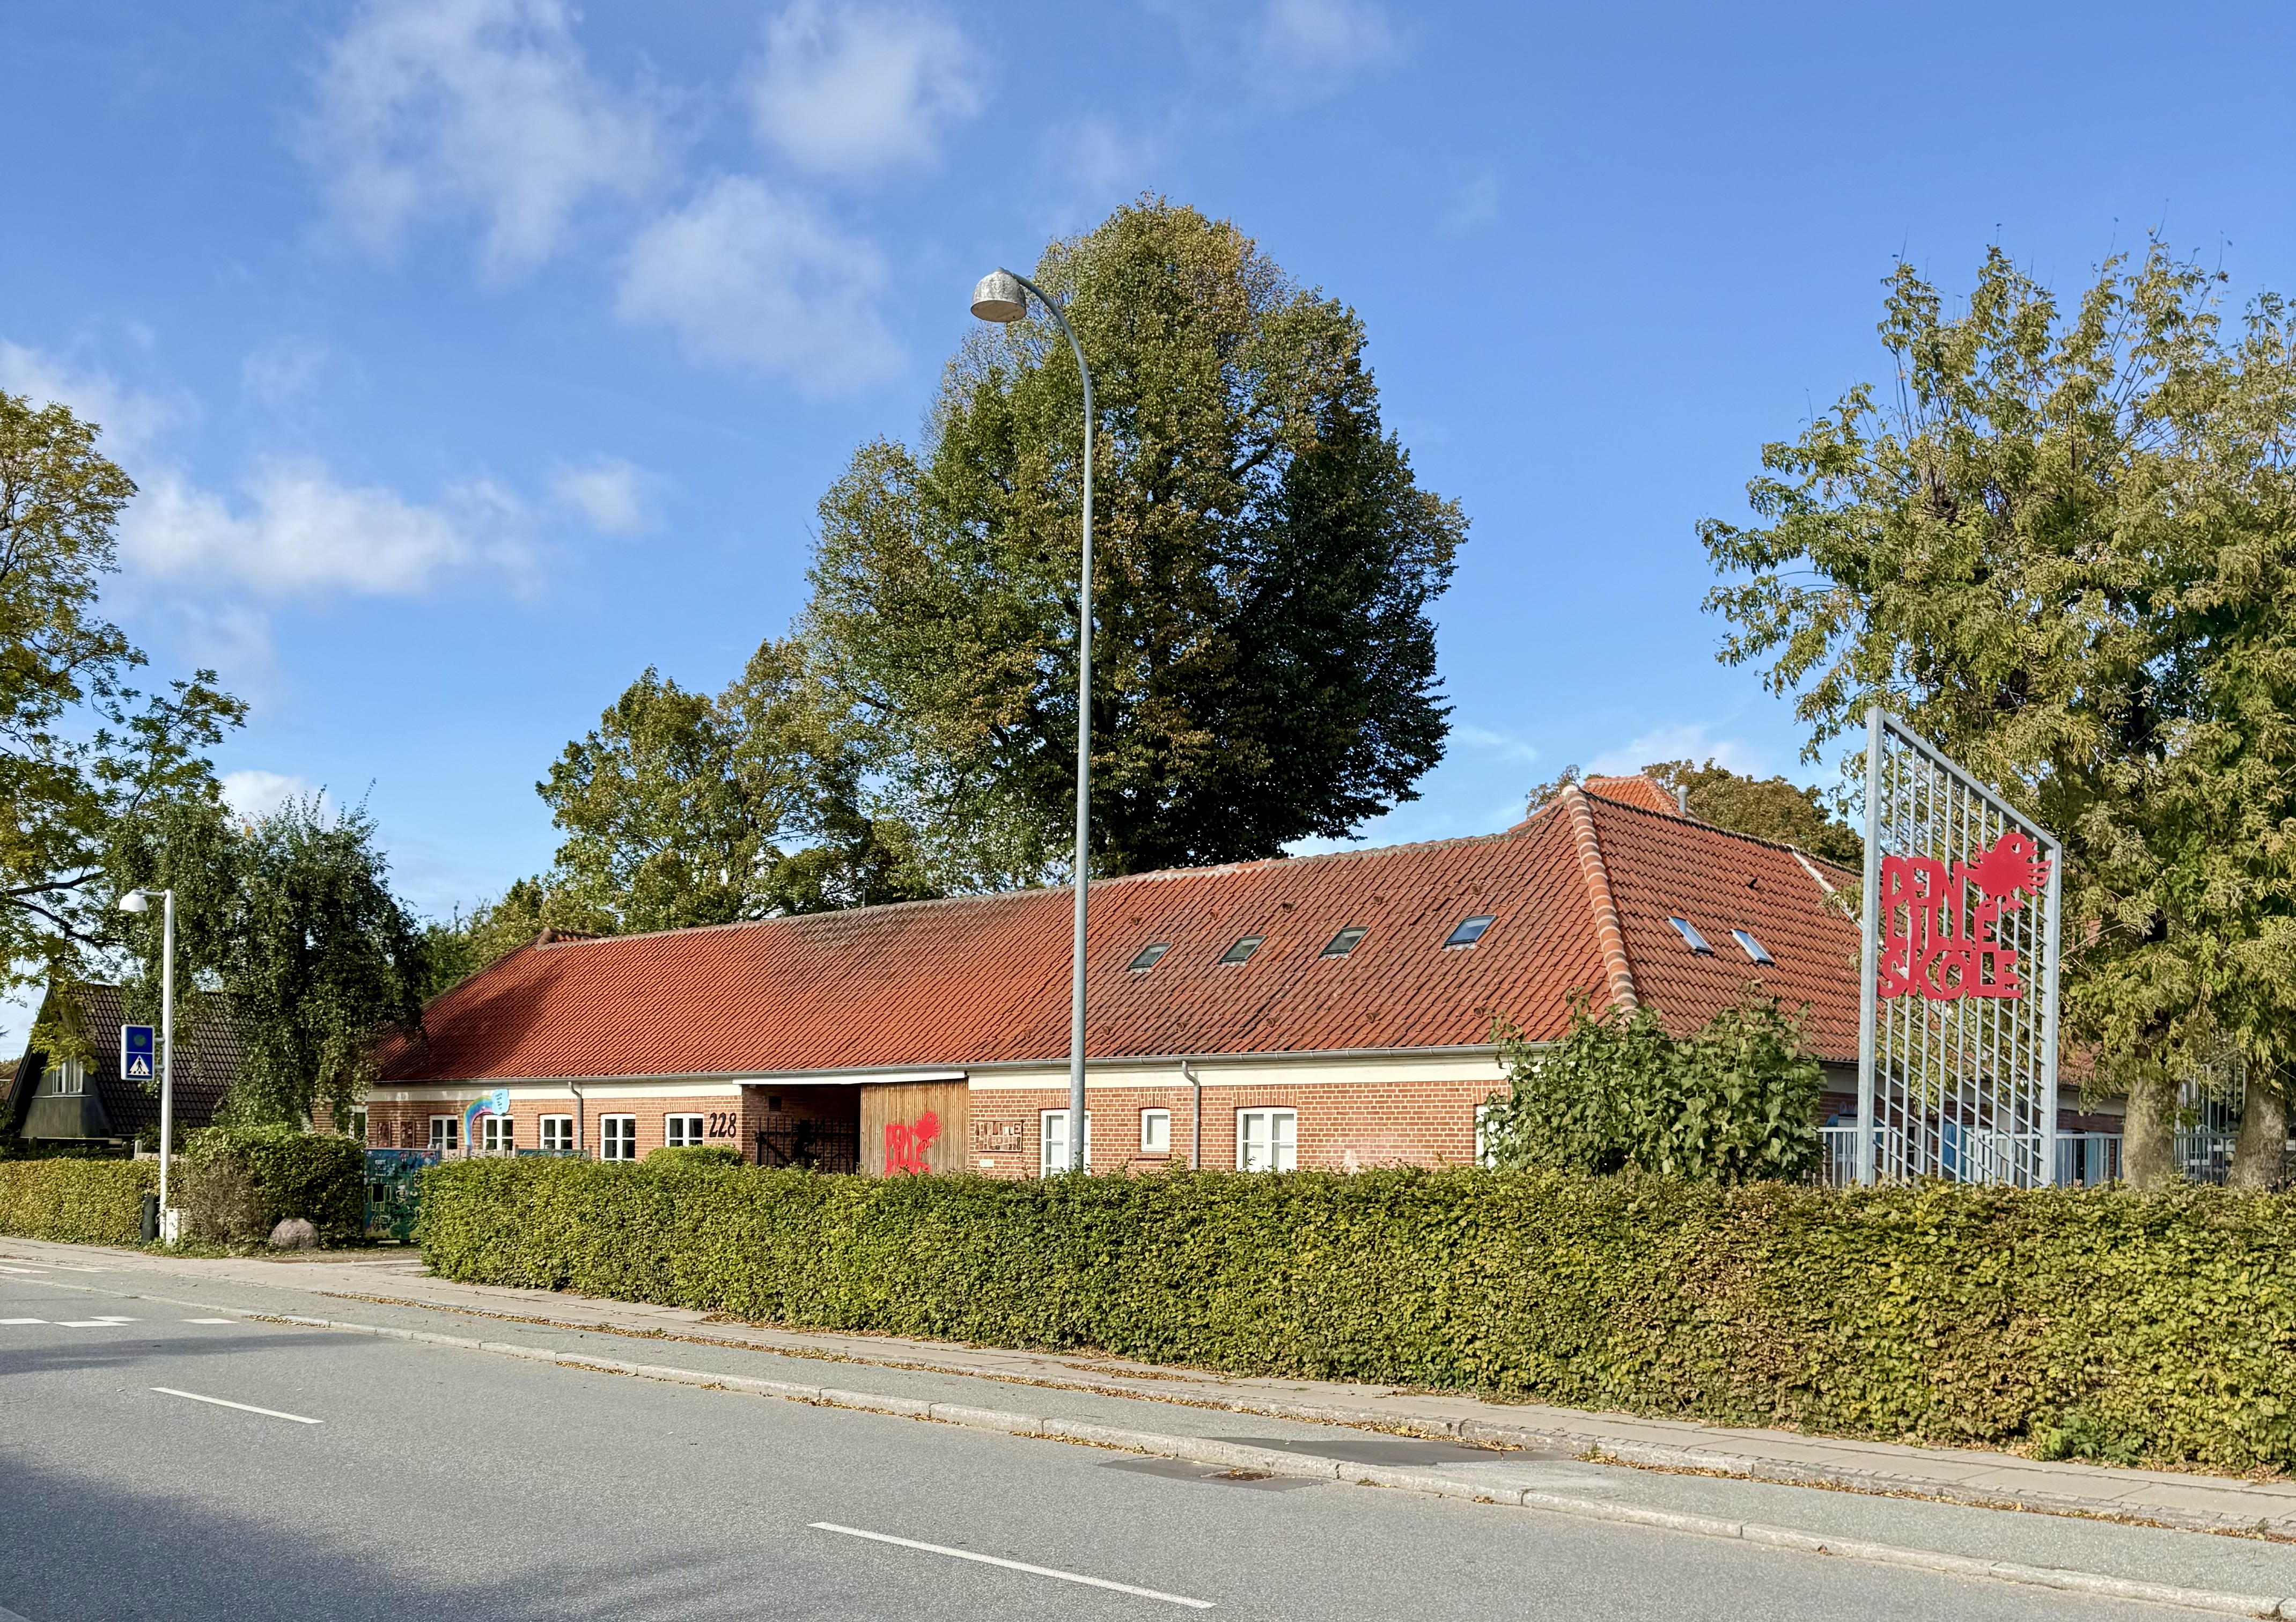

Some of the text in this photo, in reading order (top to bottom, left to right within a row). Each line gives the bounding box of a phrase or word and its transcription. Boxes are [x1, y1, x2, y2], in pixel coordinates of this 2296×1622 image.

[1882, 856, 1964, 908] DEN
[1878, 948, 2022, 1000] SKOLE
[709, 1112, 736, 1137] 228
